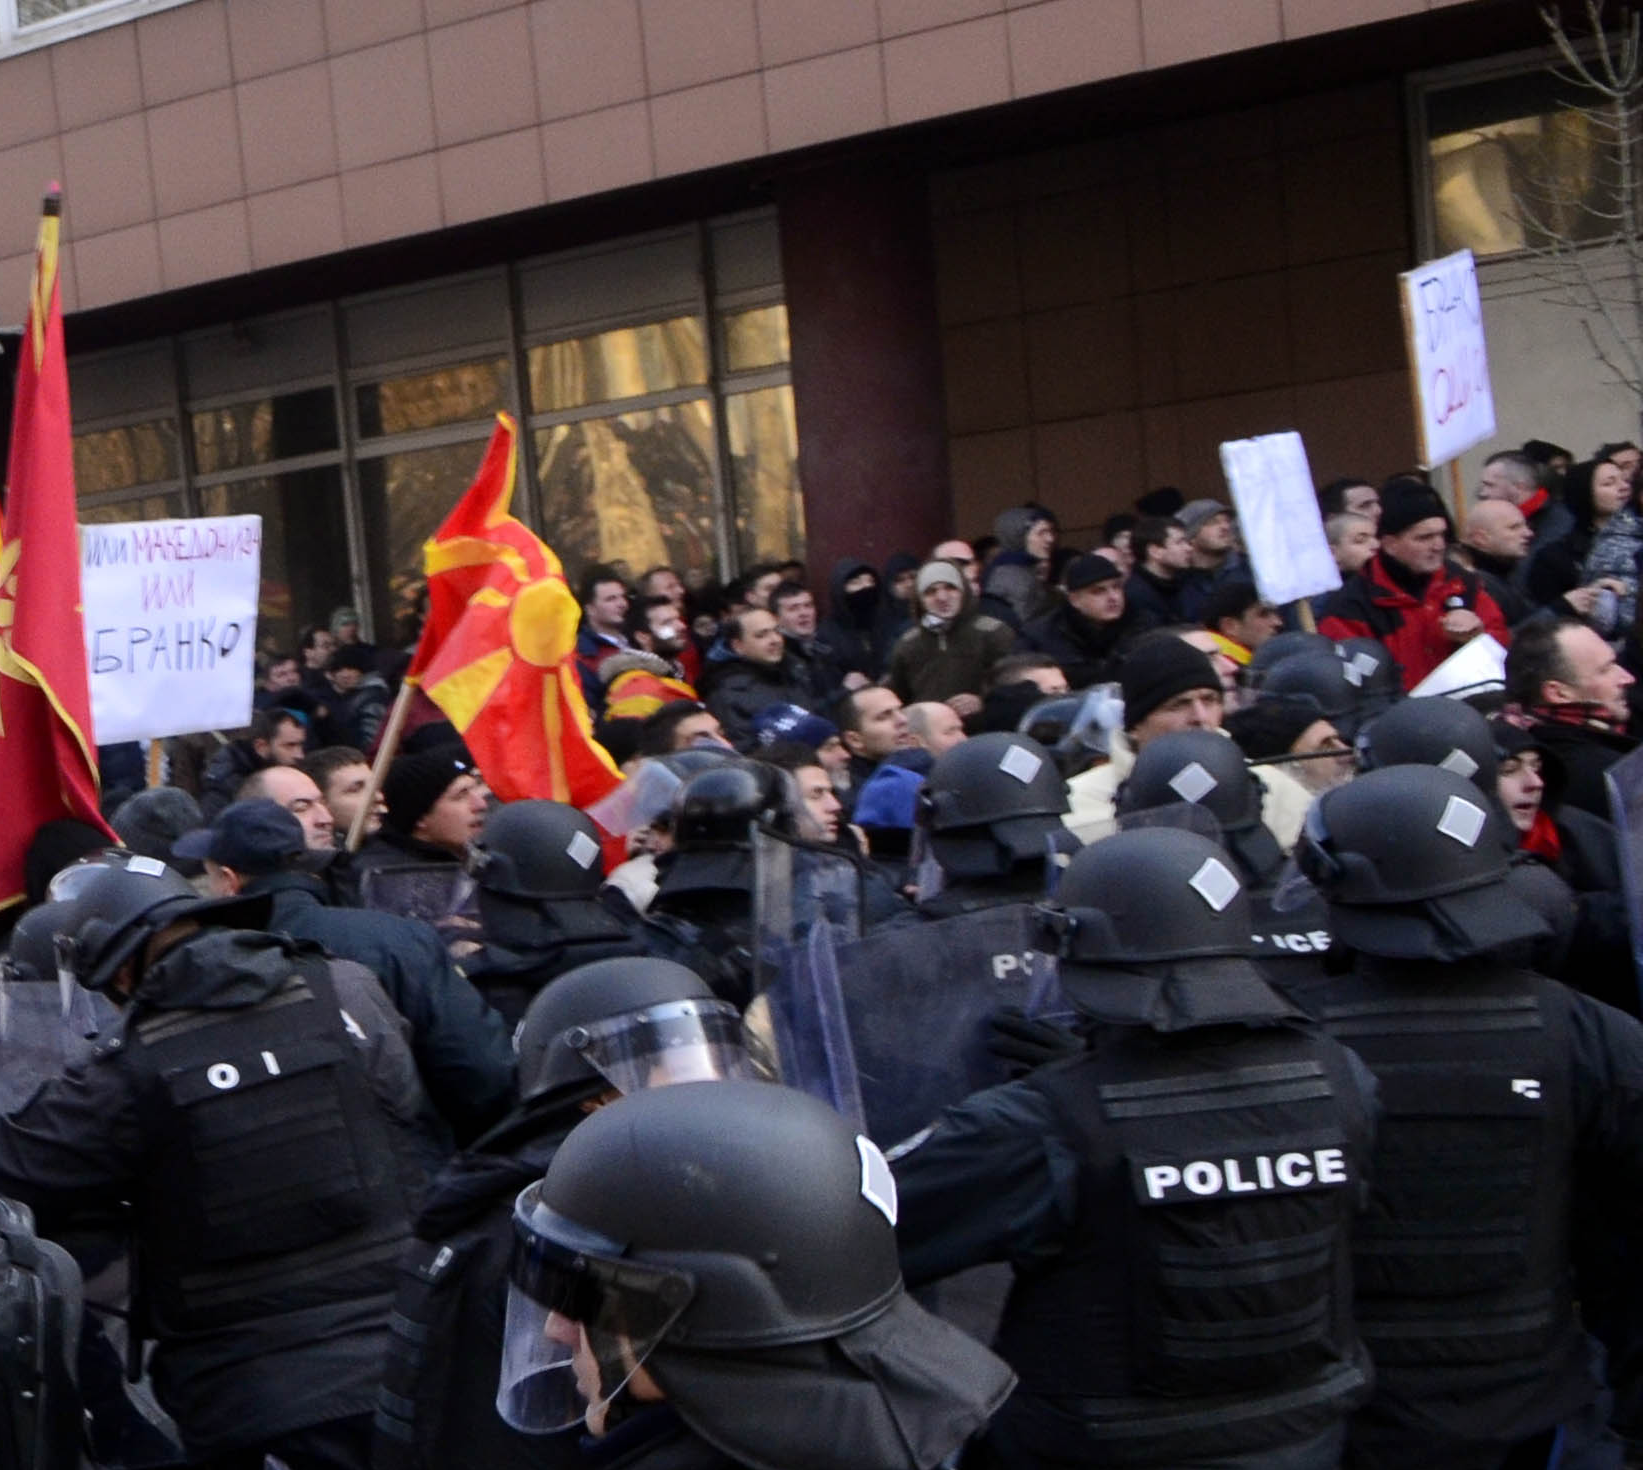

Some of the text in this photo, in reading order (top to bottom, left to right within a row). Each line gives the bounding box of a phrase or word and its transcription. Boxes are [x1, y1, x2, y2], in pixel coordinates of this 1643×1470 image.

[141, 569, 195, 613] ИЛИ
[92, 616, 242, 675] БРАНКО
[1144, 1148, 1347, 1200] POLICE
